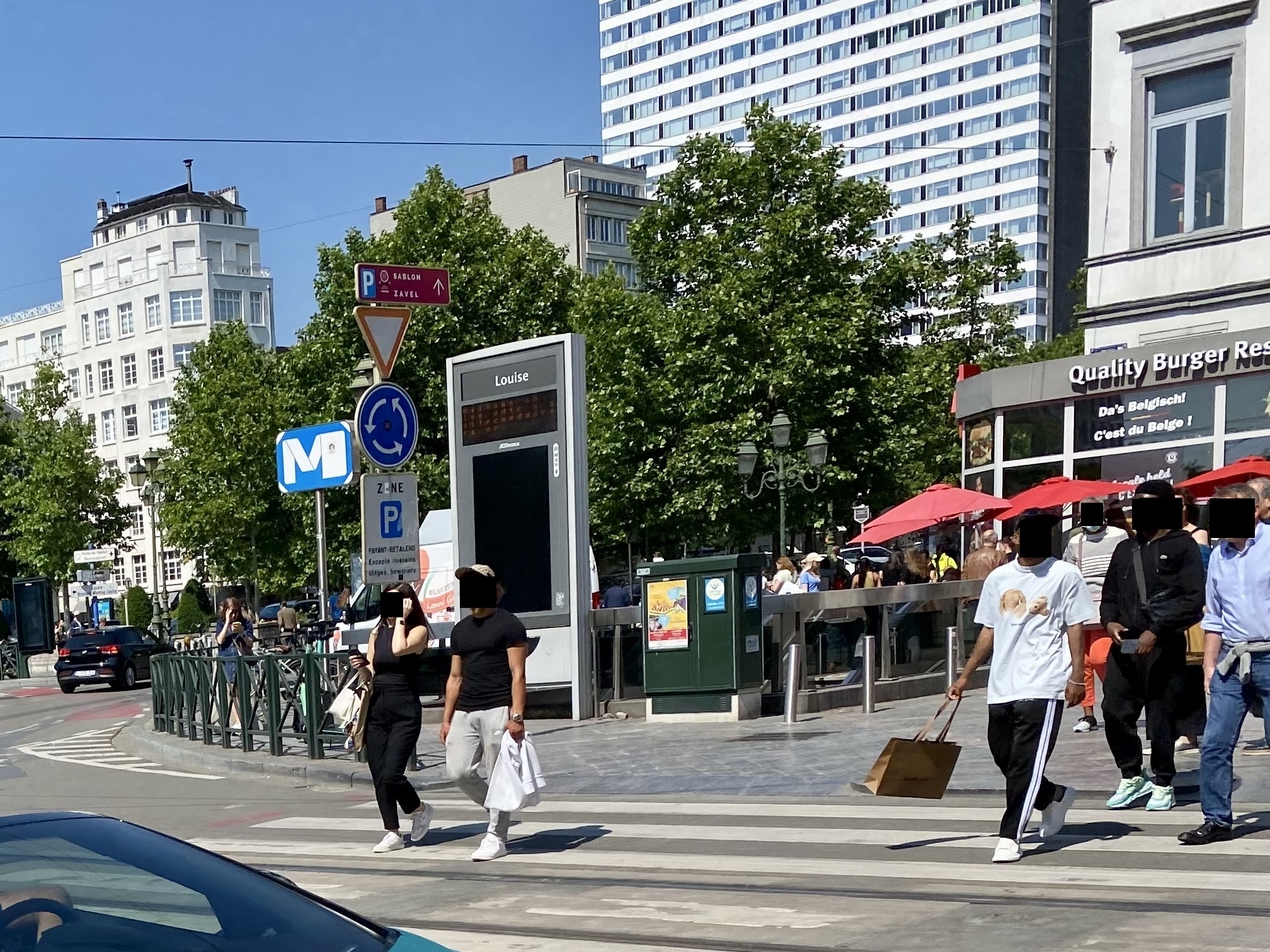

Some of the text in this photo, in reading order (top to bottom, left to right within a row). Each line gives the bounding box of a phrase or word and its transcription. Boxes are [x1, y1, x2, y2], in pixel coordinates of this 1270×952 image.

[393, 272, 421, 281] SABLON
[393, 289, 419, 298] ZAVEL
[1068, 358, 1147, 384] Quality
[1152, 347, 1228, 370] Burger
[494, 371, 530, 387] Louise
[1098, 392, 1187, 418] Da's Belgisch!
[1093, 415, 1193, 441] C'est du Belge !
[282, 430, 347, 485] M
[377, 482, 404, 494] ZNE
